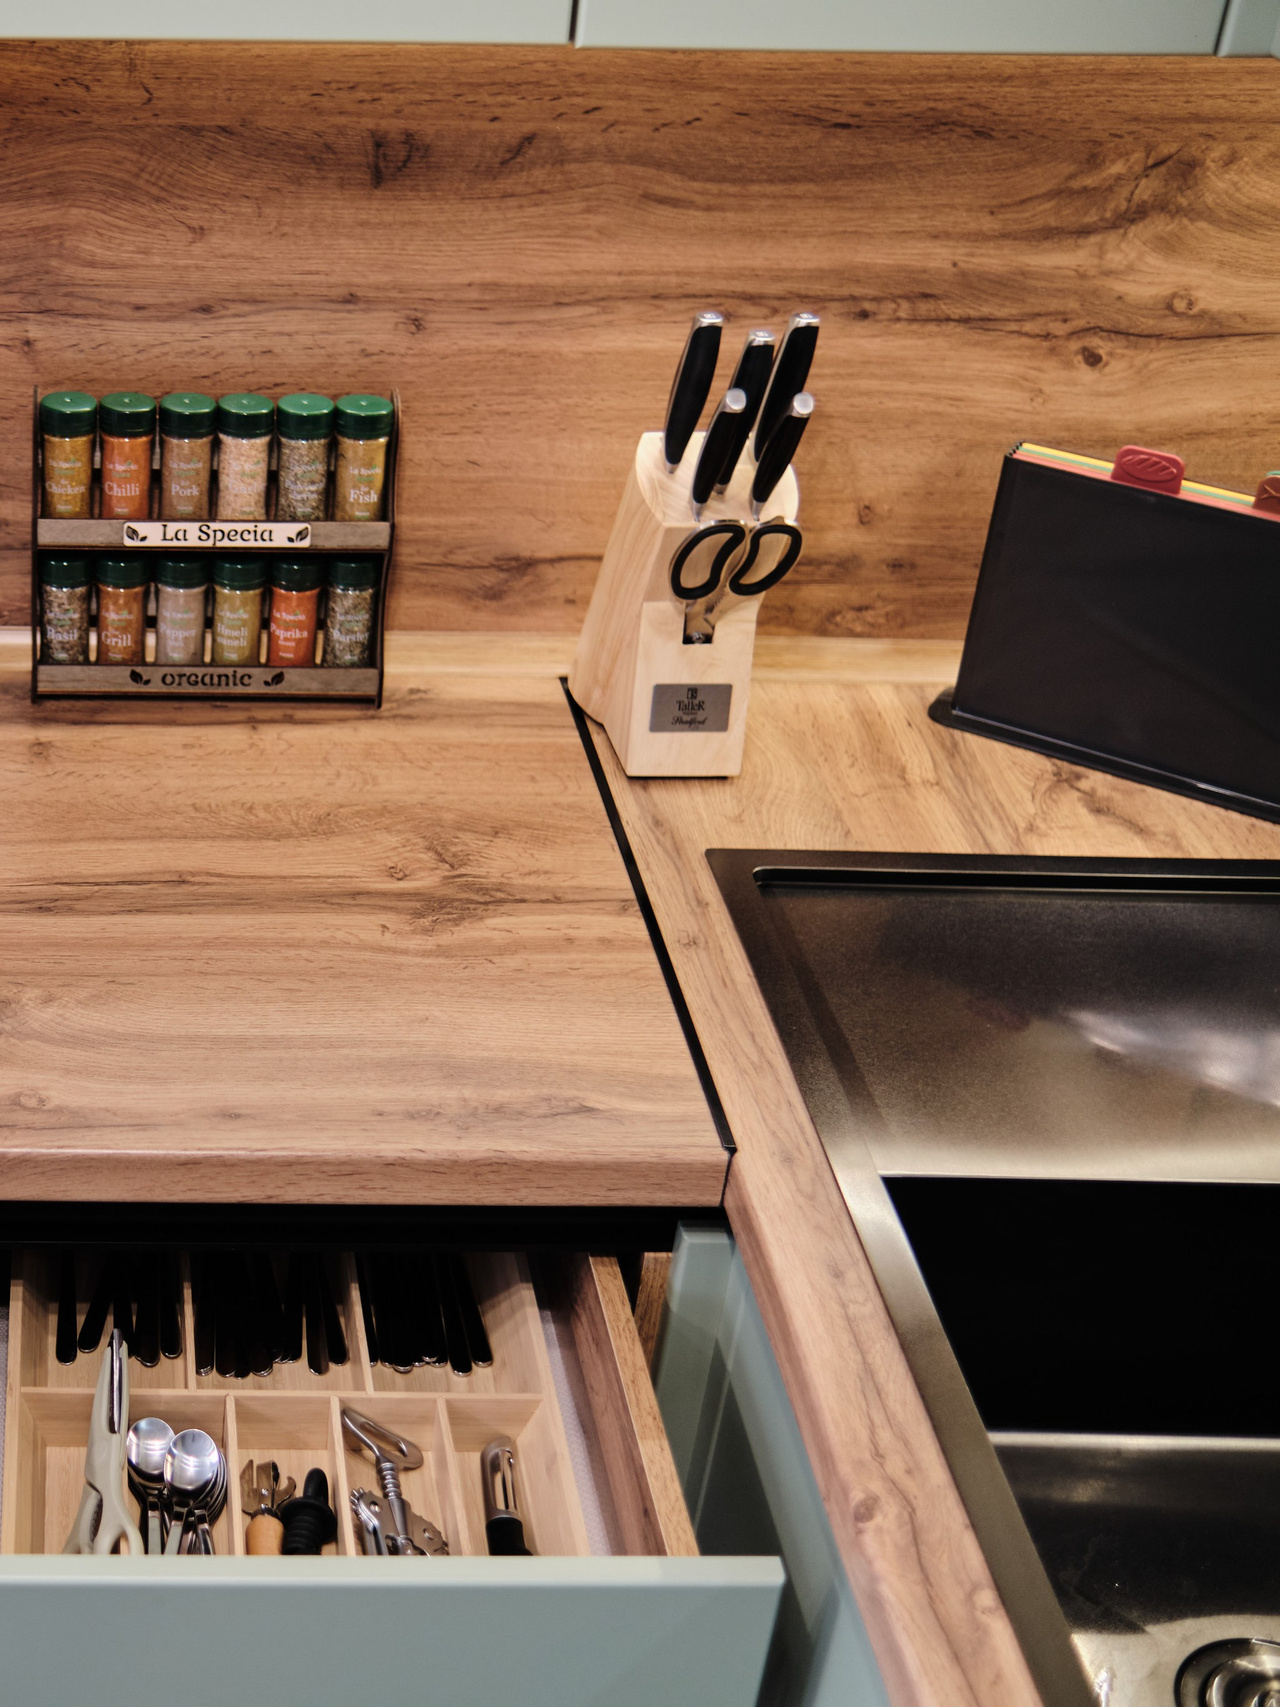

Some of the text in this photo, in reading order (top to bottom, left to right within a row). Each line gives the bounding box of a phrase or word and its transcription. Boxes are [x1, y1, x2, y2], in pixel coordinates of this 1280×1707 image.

[45, 481, 86, 494] Chicken
[104, 481, 140, 497] Chilli
[171, 483, 199, 496] Pork
[349, 489, 378, 503] Fish
[161, 524, 274, 546] La Specia
[46, 625, 77, 640] Basil
[160, 622, 197, 641] Pepper
[217, 622, 248, 637] Hmeli
[270, 622, 308, 641] Paprika
[102, 631, 131, 647] Grill
[161, 670, 252, 687] organic
